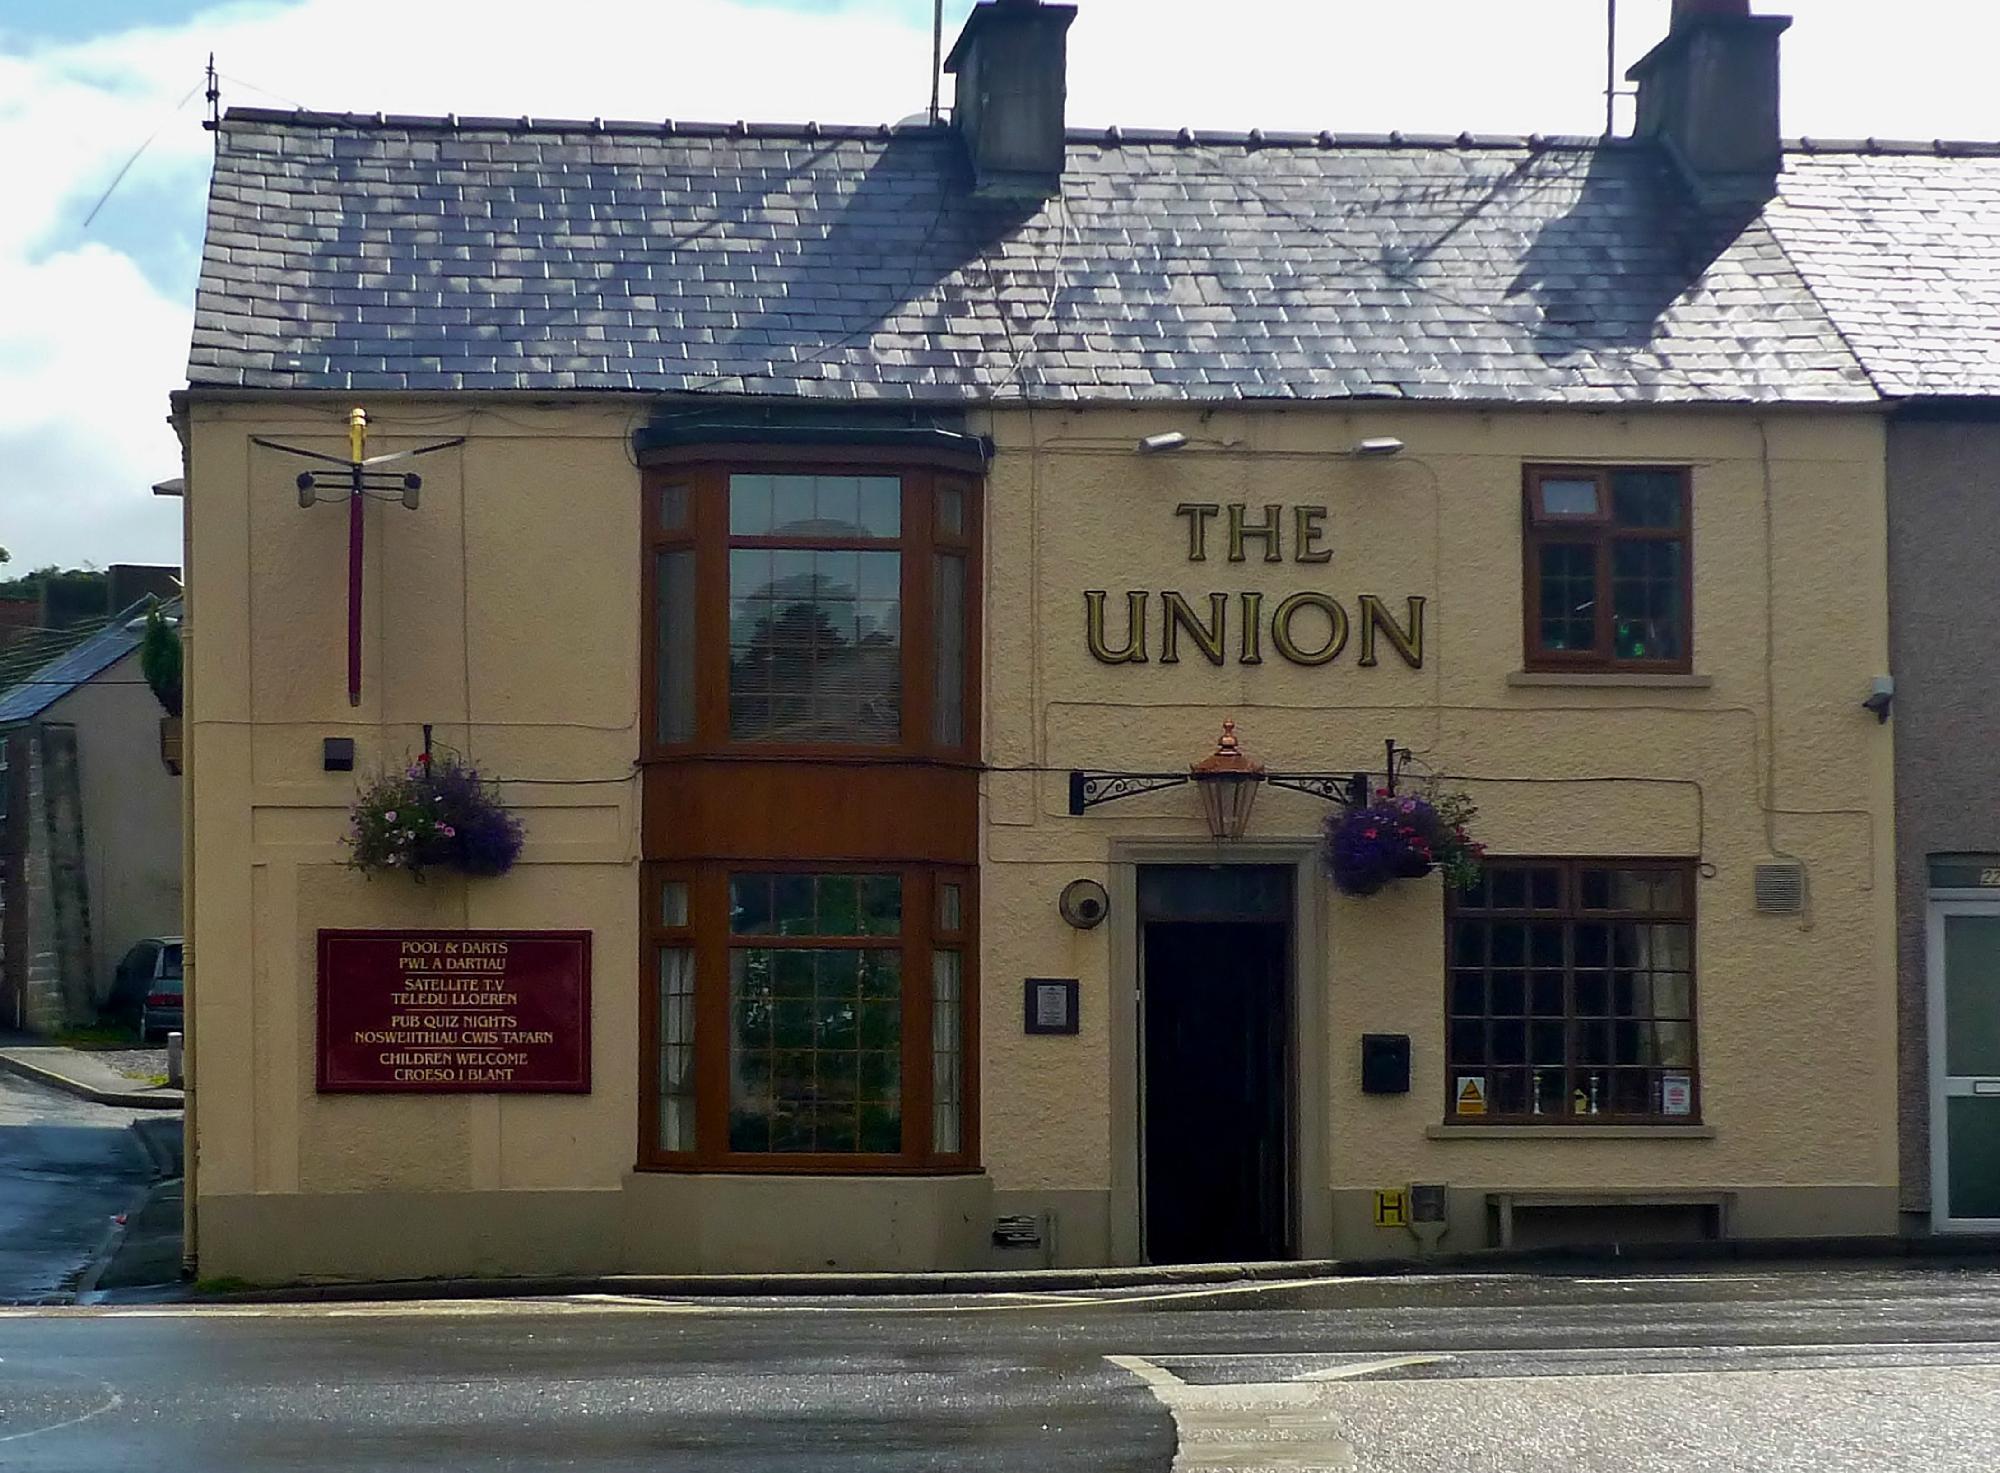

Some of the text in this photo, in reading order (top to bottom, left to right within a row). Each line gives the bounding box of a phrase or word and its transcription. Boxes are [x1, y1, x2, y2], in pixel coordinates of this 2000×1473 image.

[1176, 503, 1334, 563] THE
[1084, 590, 1427, 669] UNION
[401, 942, 509, 954] POOL & DARTS
[399, 957, 506, 970] PWL A DARTIAU
[404, 978, 479, 991] SATELLITE
[391, 993, 518, 1005] TELEDU LLOEREN
[391, 1015, 518, 1029] PUB QUIZ NIGHTS
[461, 1031, 498, 1044] CWIS
[502, 1031, 554, 1044] TAFARN
[379, 1052, 528, 1065] CHILDREN WELCOME
[394, 1068, 514, 1081] CROESO I BLANT
[1380, 1193, 1402, 1223] H
